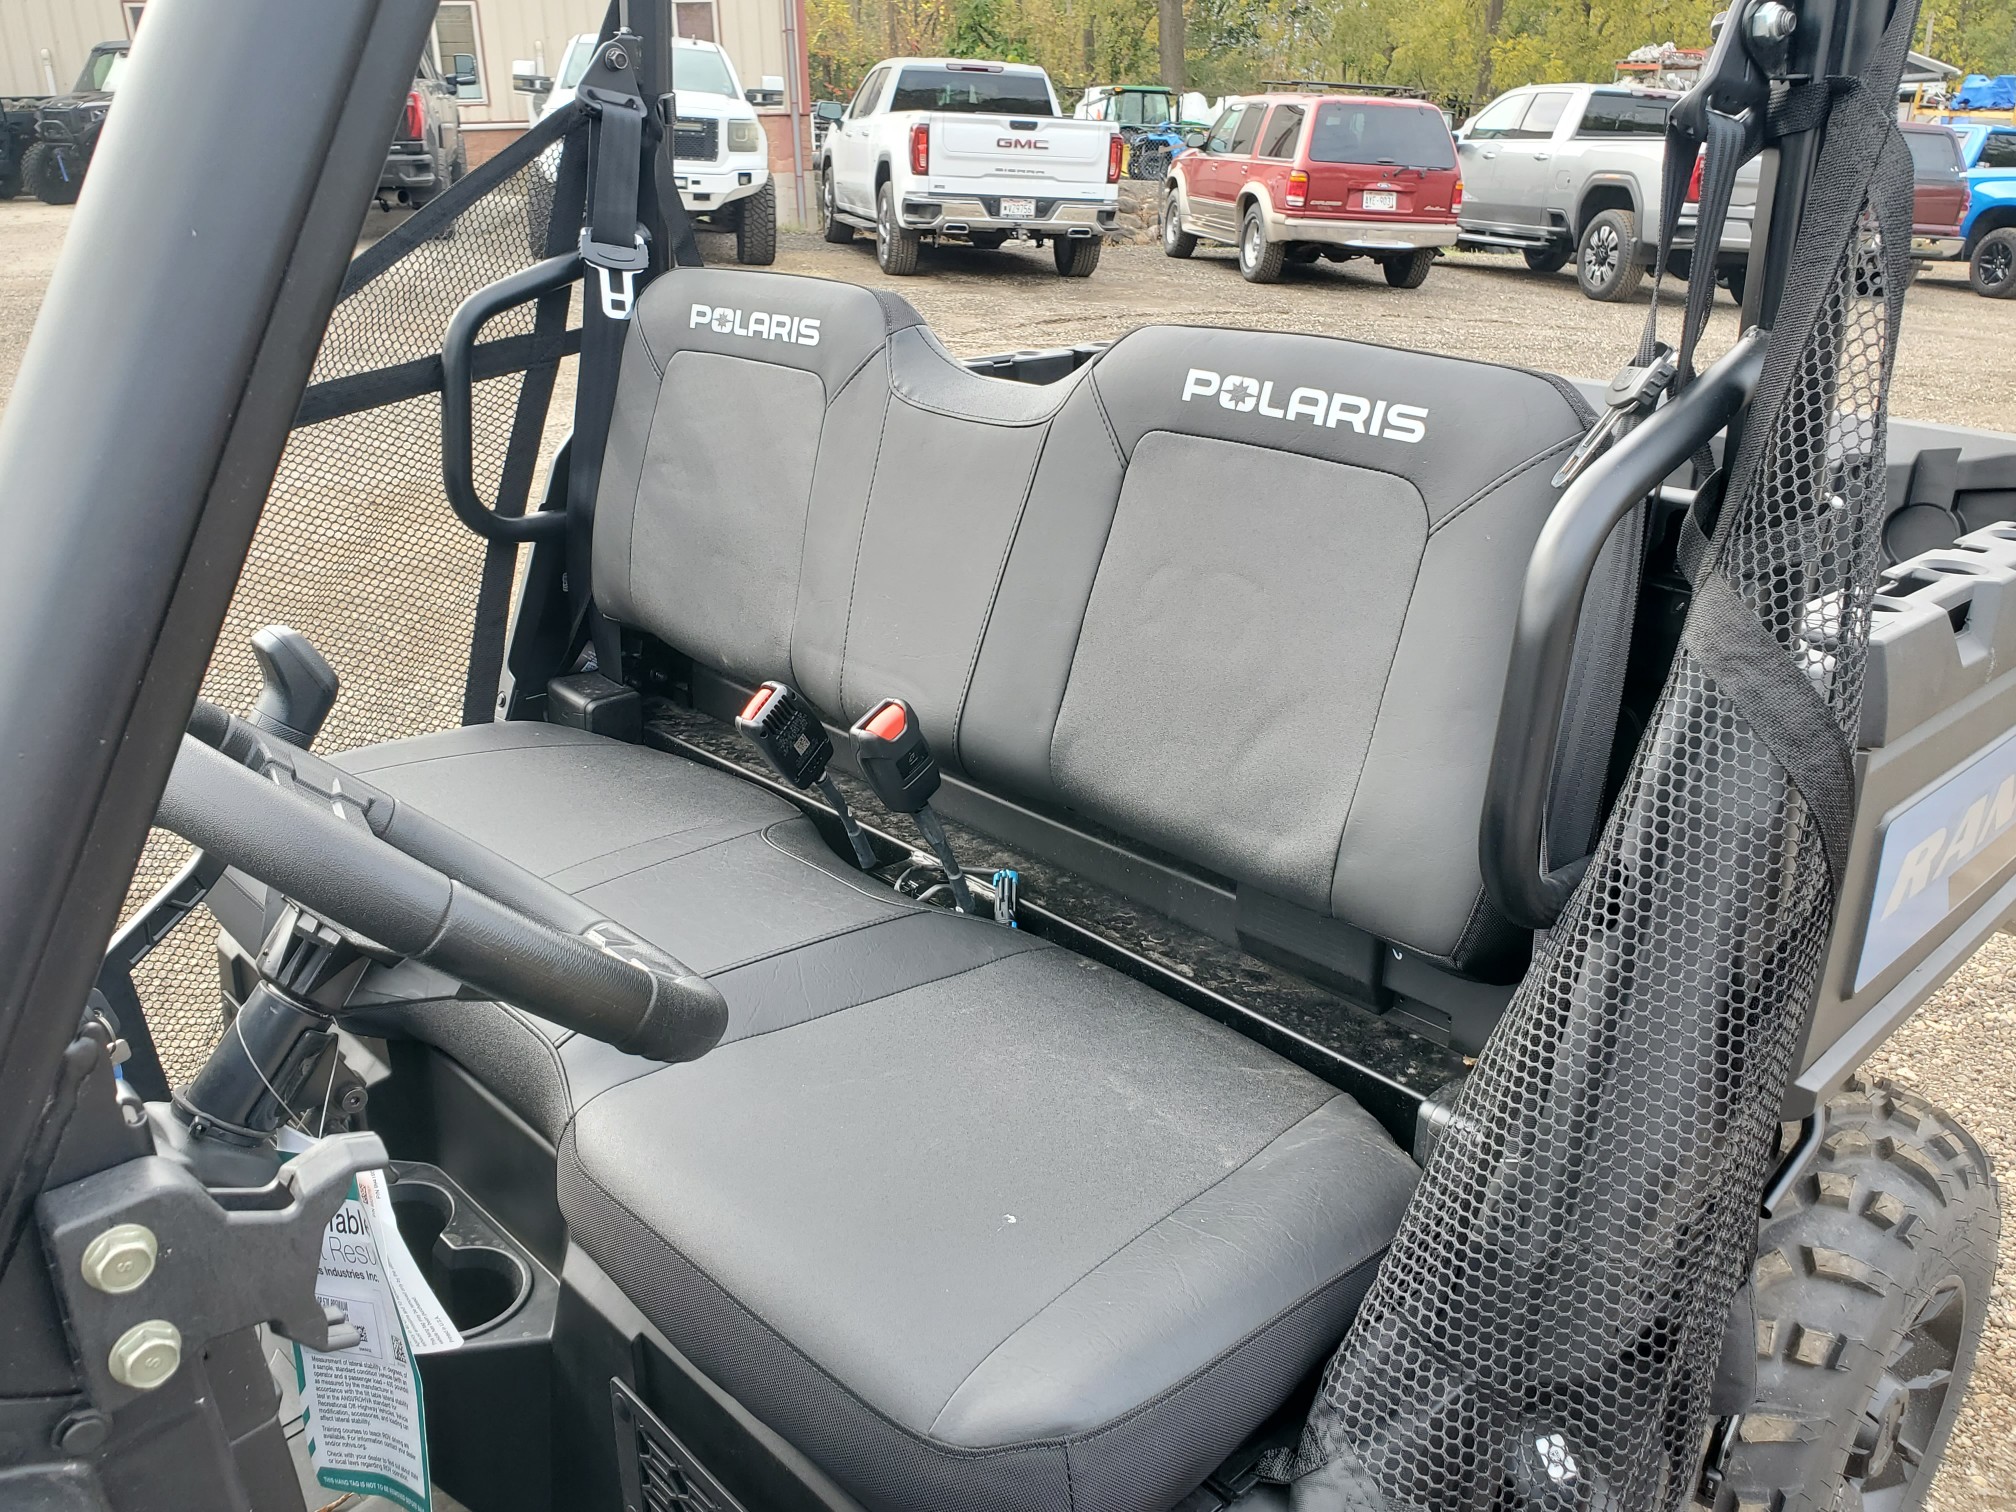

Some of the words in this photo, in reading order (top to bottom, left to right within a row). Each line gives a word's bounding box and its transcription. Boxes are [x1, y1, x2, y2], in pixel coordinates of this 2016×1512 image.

[996, 138, 1049, 150] GMC
[689, 303, 821, 346] POLARIS
[1182, 368, 1428, 443] POLARIS
[324, 1267, 365, 1280] Industries
[366, 1270, 379, 1283] Inc.
